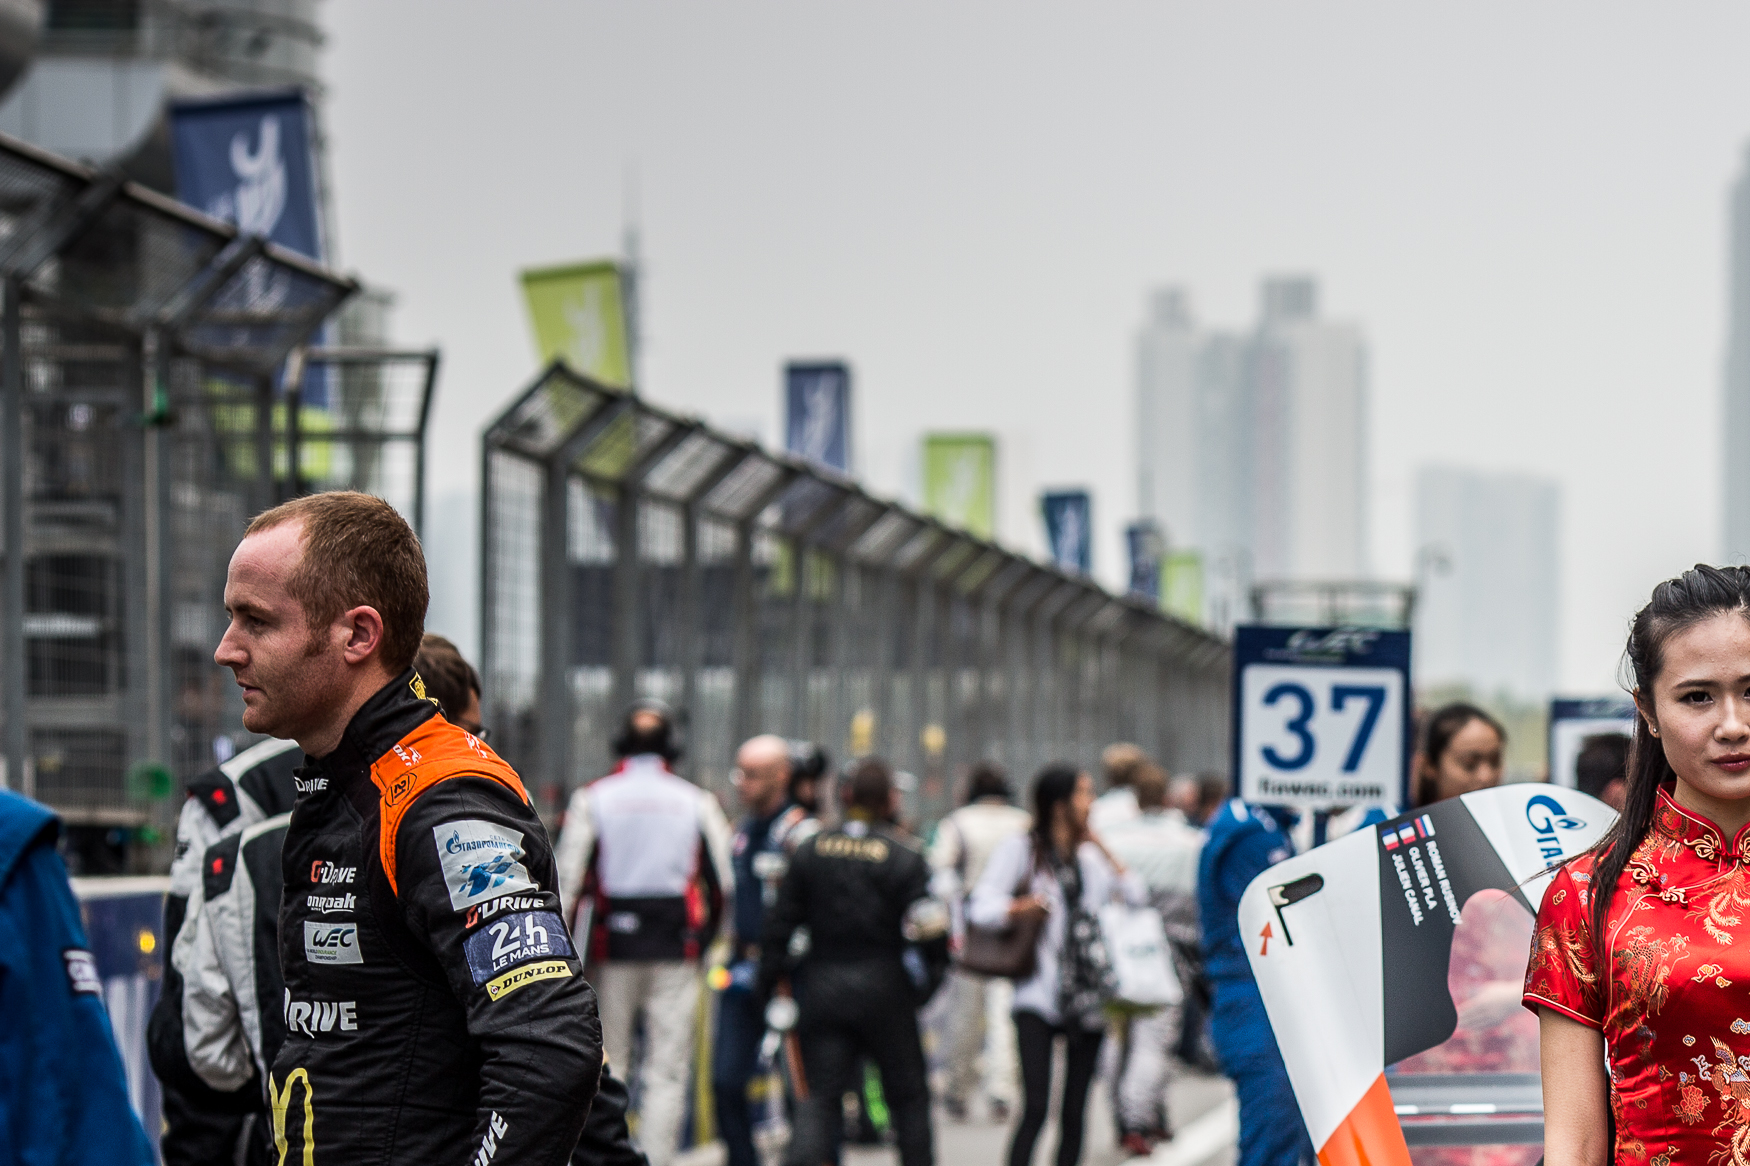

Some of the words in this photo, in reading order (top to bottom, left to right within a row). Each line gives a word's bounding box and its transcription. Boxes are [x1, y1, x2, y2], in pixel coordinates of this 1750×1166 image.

[1262, 682, 1385, 772] 37
[1425, 840, 1446, 879] ROMAN
[1391, 853, 1409, 891] JULIEN
[1404, 889, 1424, 927] CANAL
[1421, 881, 1438, 910] PLA
[312, 927, 355, 948] WEC
[488, 914, 549, 961] 24h
[492, 957, 508, 972] LE
[509, 945, 550, 963] MANS
[502, 965, 566, 990] DUNLOP
[284, 986, 358, 1039] RIVE
